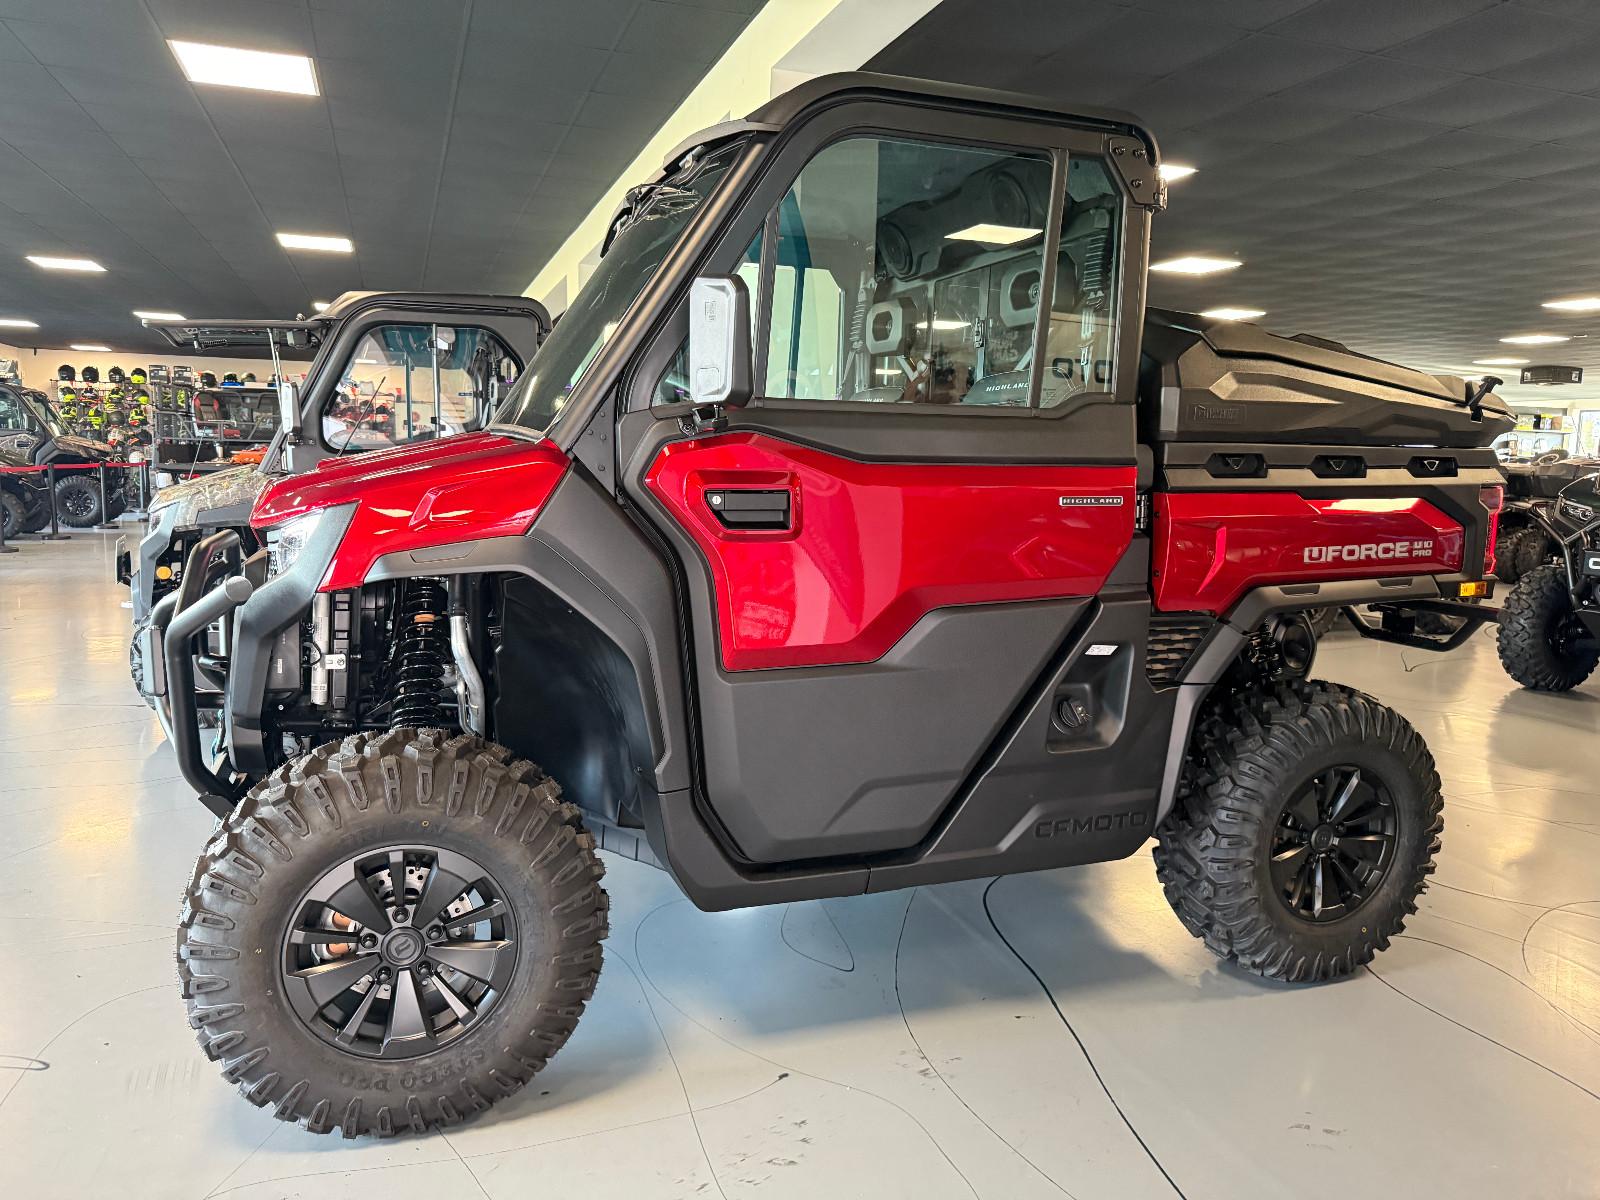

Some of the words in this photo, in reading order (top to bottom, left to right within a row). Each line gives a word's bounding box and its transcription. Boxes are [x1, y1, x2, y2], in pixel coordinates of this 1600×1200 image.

[1303, 541, 1409, 563] UFORCE
[1412, 549, 1432, 557] PRO
[1034, 811, 1148, 839] CFMOTO
